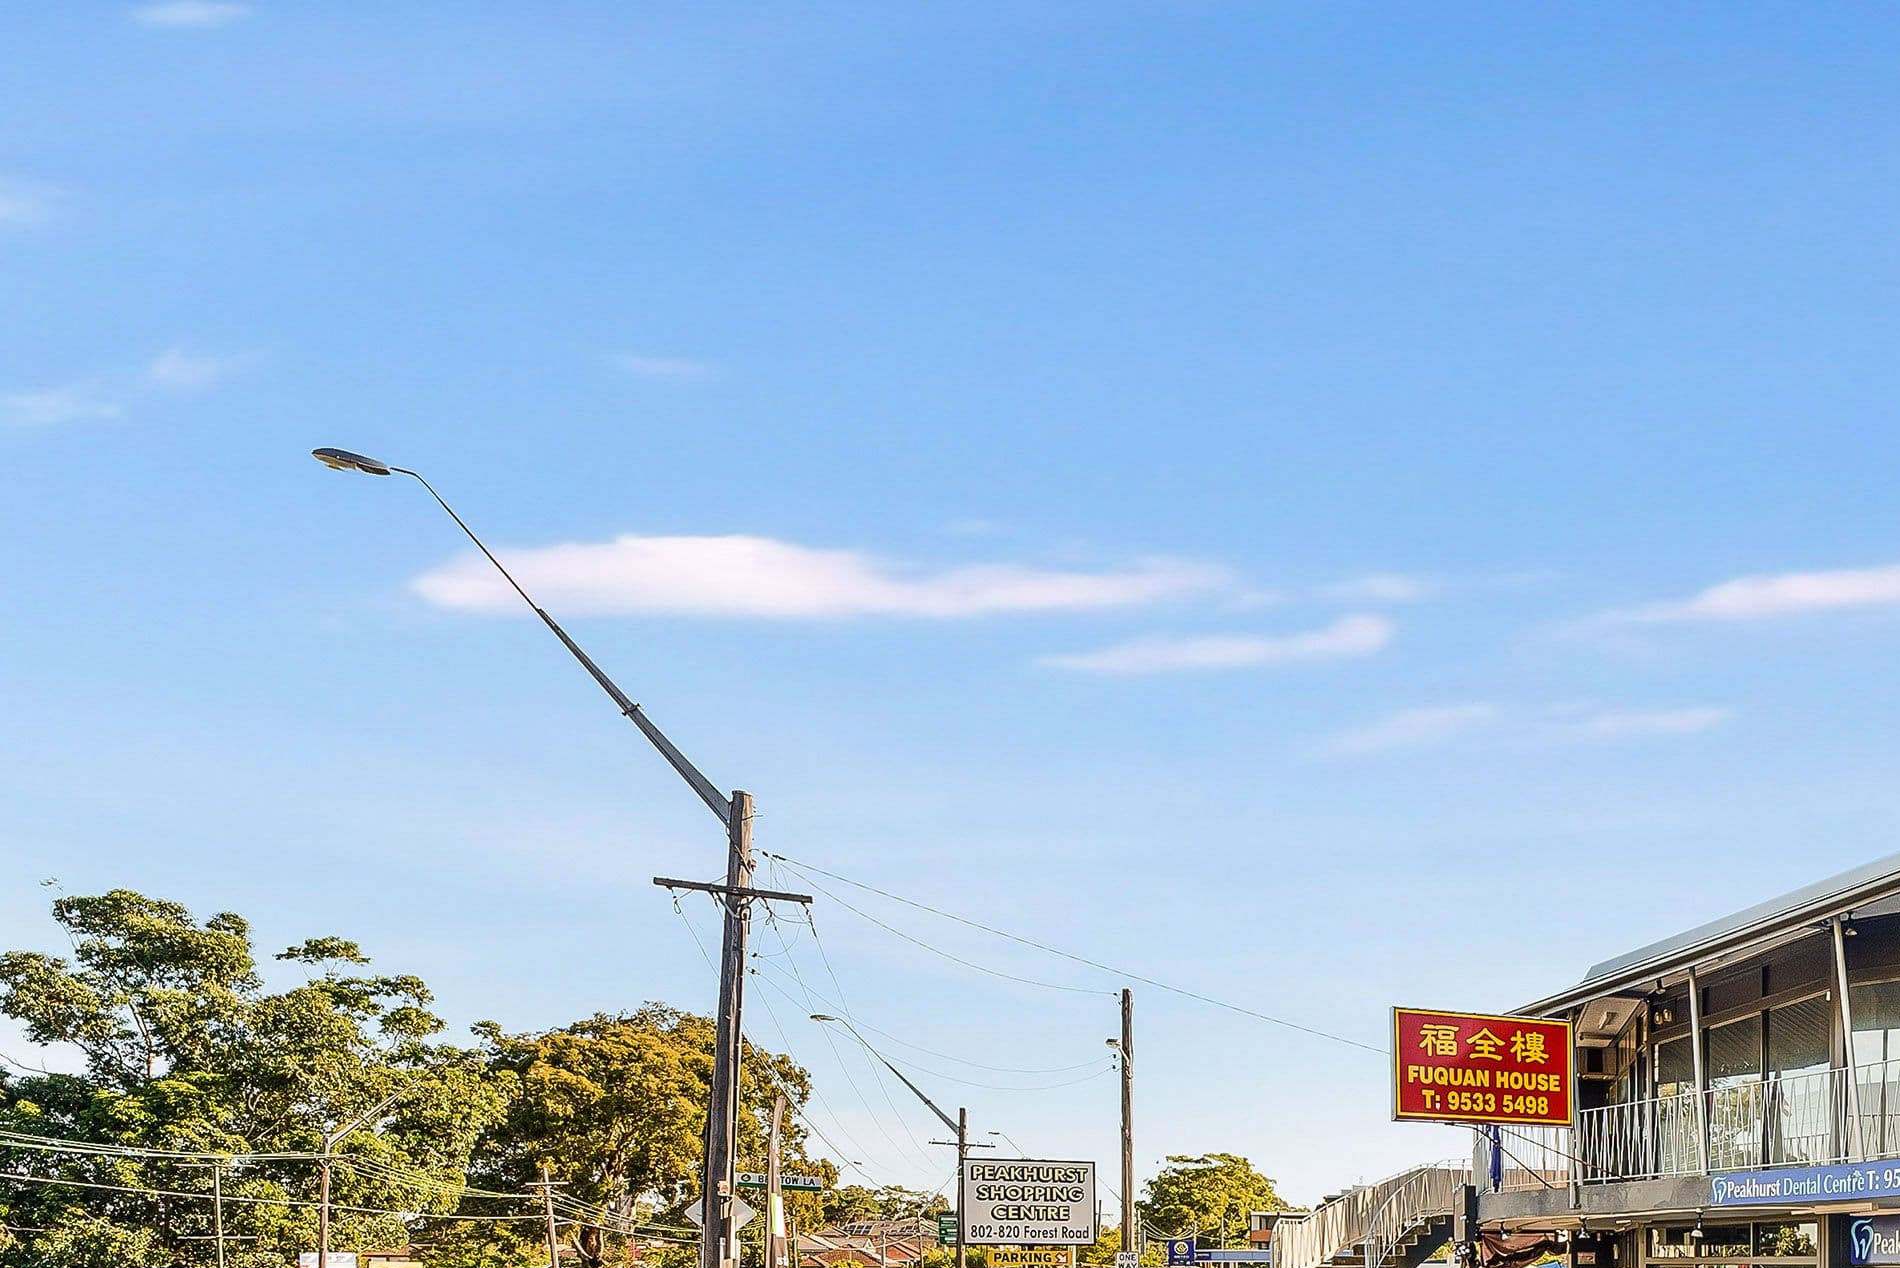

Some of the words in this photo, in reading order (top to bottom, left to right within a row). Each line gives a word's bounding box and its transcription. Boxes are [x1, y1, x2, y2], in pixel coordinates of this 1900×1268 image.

[1418, 1023, 1550, 1065] 福全樓
[1407, 1065, 1490, 1088] FUQUAN
[1495, 1071, 1561, 1092] HOUSE
[1447, 1091, 1497, 1113] 9533
[1502, 1094, 1549, 1115] 5498
[803, 1177, 816, 1186] LA
[970, 1164, 1089, 1184] PEAKHURST
[975, 1184, 1085, 1202] SHOPPING
[1727, 1177, 1782, 1199] Peakhurst
[1783, 1174, 1821, 1196] Dental
[1823, 1171, 1865, 1195] Centre
[1866, 1170, 1880, 1191] T:
[990, 1204, 1071, 1222] CENTRE
[970, 1225, 1020, 1239] 802-820
[1023, 1225, 1058, 1239] Forest
[1061, 1226, 1089, 1239] Road
[993, 1252, 1052, 1263] PARKING
[1118, 1253, 1137, 1261] ONE
